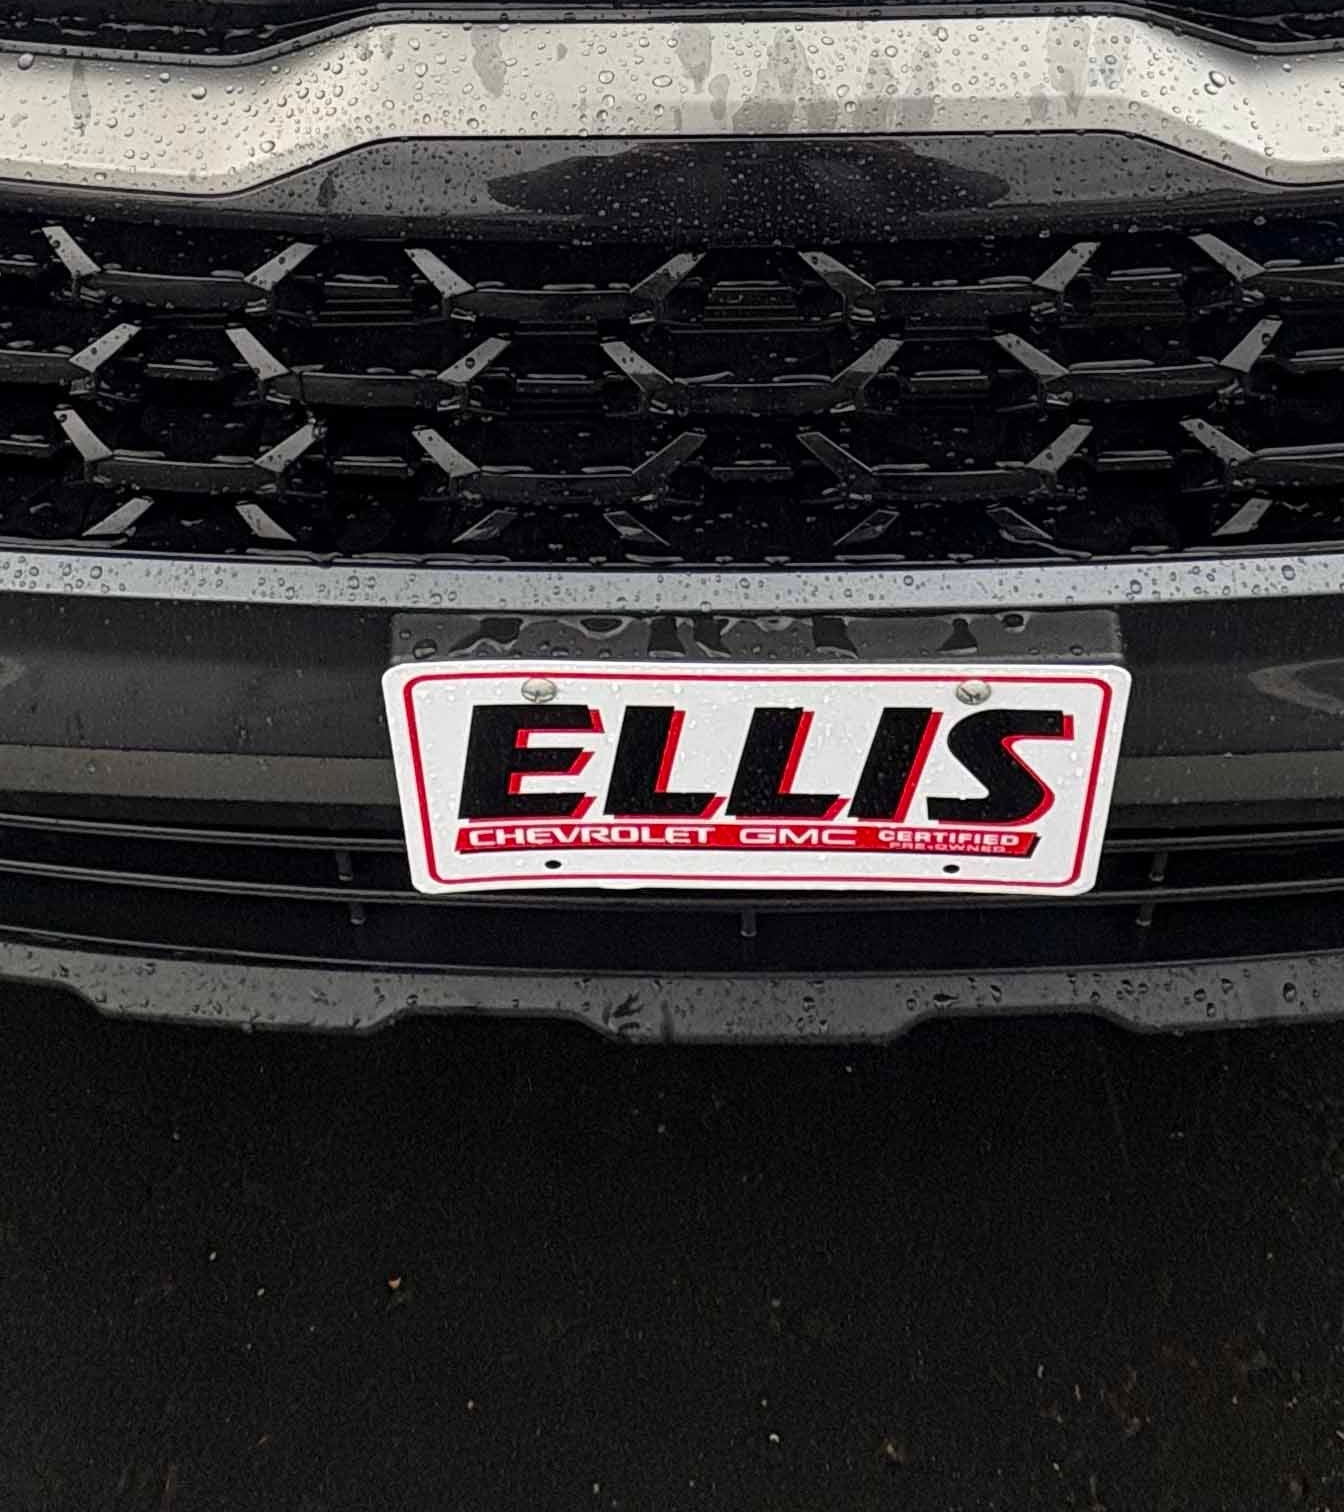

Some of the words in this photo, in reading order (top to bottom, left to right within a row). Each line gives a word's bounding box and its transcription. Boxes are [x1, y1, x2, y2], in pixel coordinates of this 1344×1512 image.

[458, 705, 1074, 826] ELLIS
[469, 826, 716, 846] CHEVROLET
[739, 828, 857, 846] GMC
[878, 829, 1019, 846] CERTIFIED
